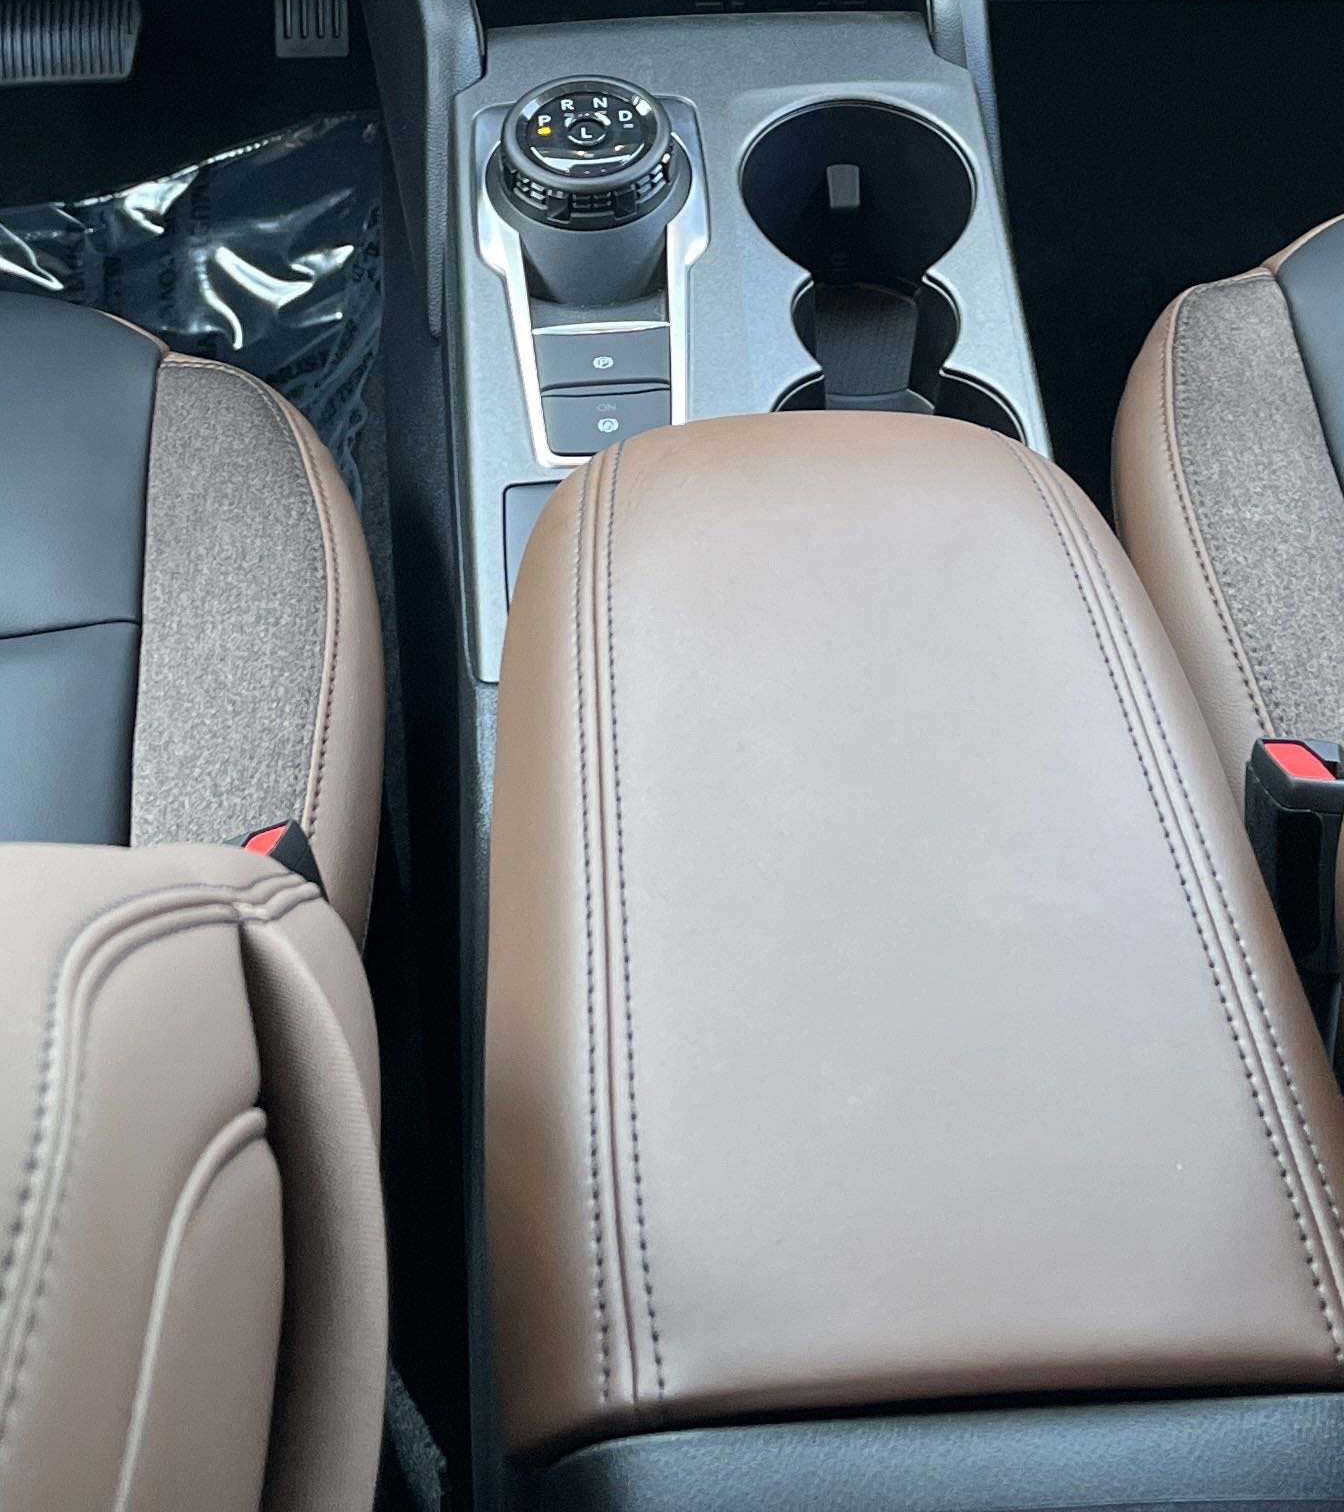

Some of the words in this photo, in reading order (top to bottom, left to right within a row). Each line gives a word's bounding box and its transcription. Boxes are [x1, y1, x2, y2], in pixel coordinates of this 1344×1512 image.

[538, 115, 552, 127] P
[560, 99, 574, 110] R
[593, 97, 608, 108] N
[618, 110, 633, 122] D
[580, 127, 593, 139] L
